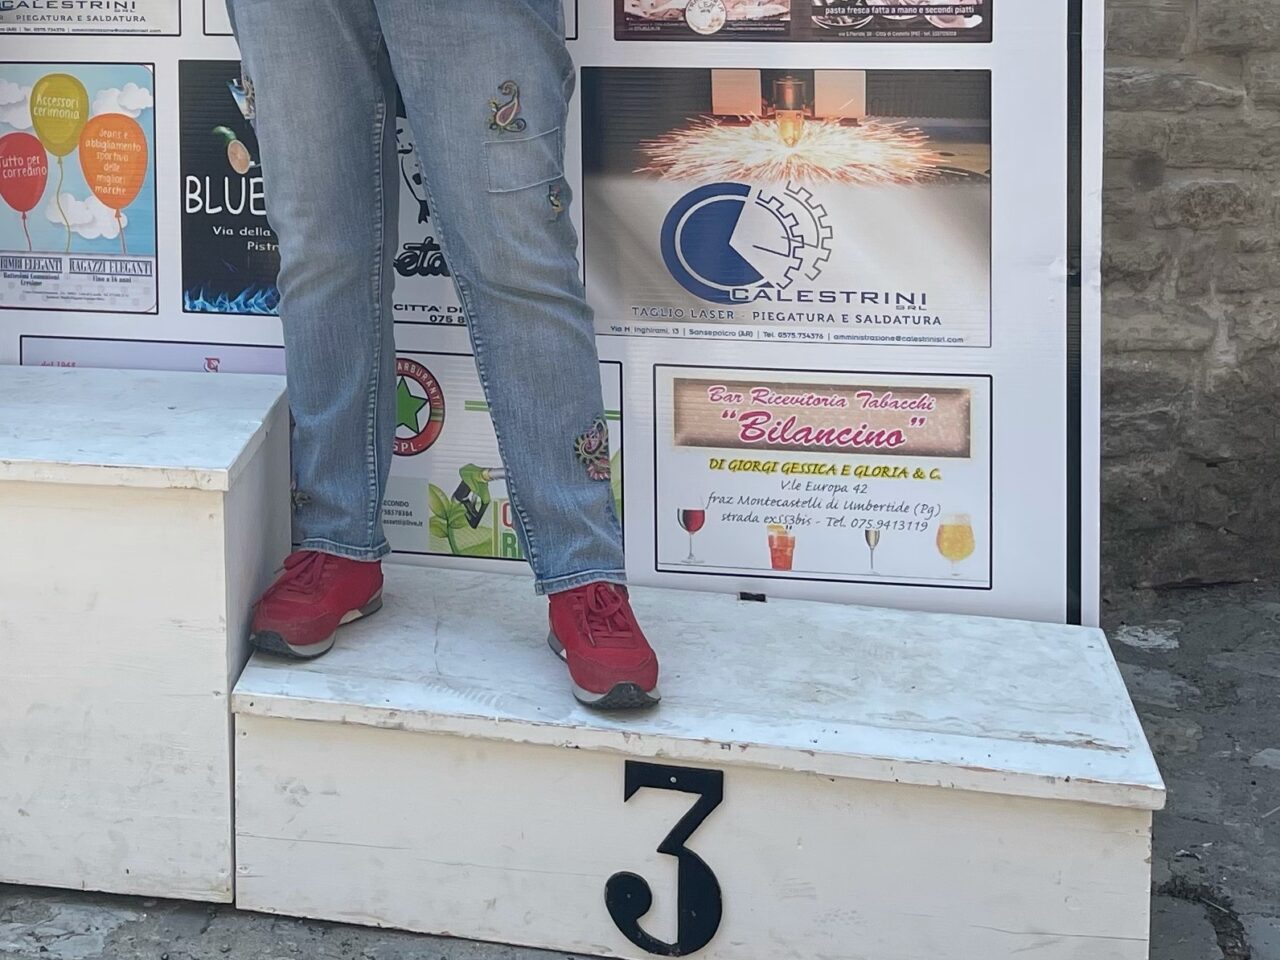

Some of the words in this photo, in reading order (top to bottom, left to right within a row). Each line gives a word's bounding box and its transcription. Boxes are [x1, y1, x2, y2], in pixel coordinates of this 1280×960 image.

[0, 0, 136, 10] CALESTRINI
[825, 6, 846, 16] pasta
[847, 6, 870, 15] fresca
[871, 6, 889, 15] fatta
[925, 6, 954, 14] secondi
[954, 6, 975, 16] piatti
[16, 14, 73, 22] PIEGATURA
[86, 14, 146, 23] SALDATURA
[35, 93, 79, 109] Accessori
[33, 105, 80, 120] cerimonia
[85, 140, 141, 153] abbigliamento
[26, 156, 40, 170] per
[103, 162, 121, 173] delle
[2, 166, 47, 179] corredino
[96, 173, 126, 185] migliori
[94, 184, 127, 195] marche
[185, 175, 267, 216] BLUE
[212, 225, 234, 236] Via
[239, 226, 271, 237] della
[69, 258, 106, 272] RAGAZZI
[109, 260, 152, 275] ELEGANTI
[730, 288, 927, 305] CALESTRINI
[393, 303, 442, 312] CITTA'
[447, 306, 462, 314] DI
[429, 314, 453, 323] 075
[631, 306, 684, 318] TAGLIO
[691, 309, 734, 320] LASER
[752, 311, 835, 324] PIEGATURA
[841, 313, 849, 323] E
[855, 314, 942, 326] SALDATURA
[708, 385, 743, 404] Bar
[751, 386, 849, 409] Ricevitoria
[856, 391, 936, 411] Tabacchi
[708, 457, 725, 470] DI
[727, 459, 780, 473] GIORGI
[780, 461, 837, 477] GESSICA
[840, 464, 851, 477] E
[854, 465, 908, 479] GLORIA
[912, 467, 925, 479] &
[928, 467, 942, 480] C.
[805, 480, 849, 495] Europa
[852, 483, 868, 494] 42
[705, 491, 734, 509] fraz
[737, 494, 822, 509] Montecastelli
[826, 497, 839, 510] di
[843, 499, 911, 513] Umbertide
[913, 502, 942, 518] (Pg)
[720, 511, 760, 523] strada
[826, 515, 847, 528] Tel.
[850, 517, 929, 532] 075.9413119
[603, 759, 724, 958] 3
